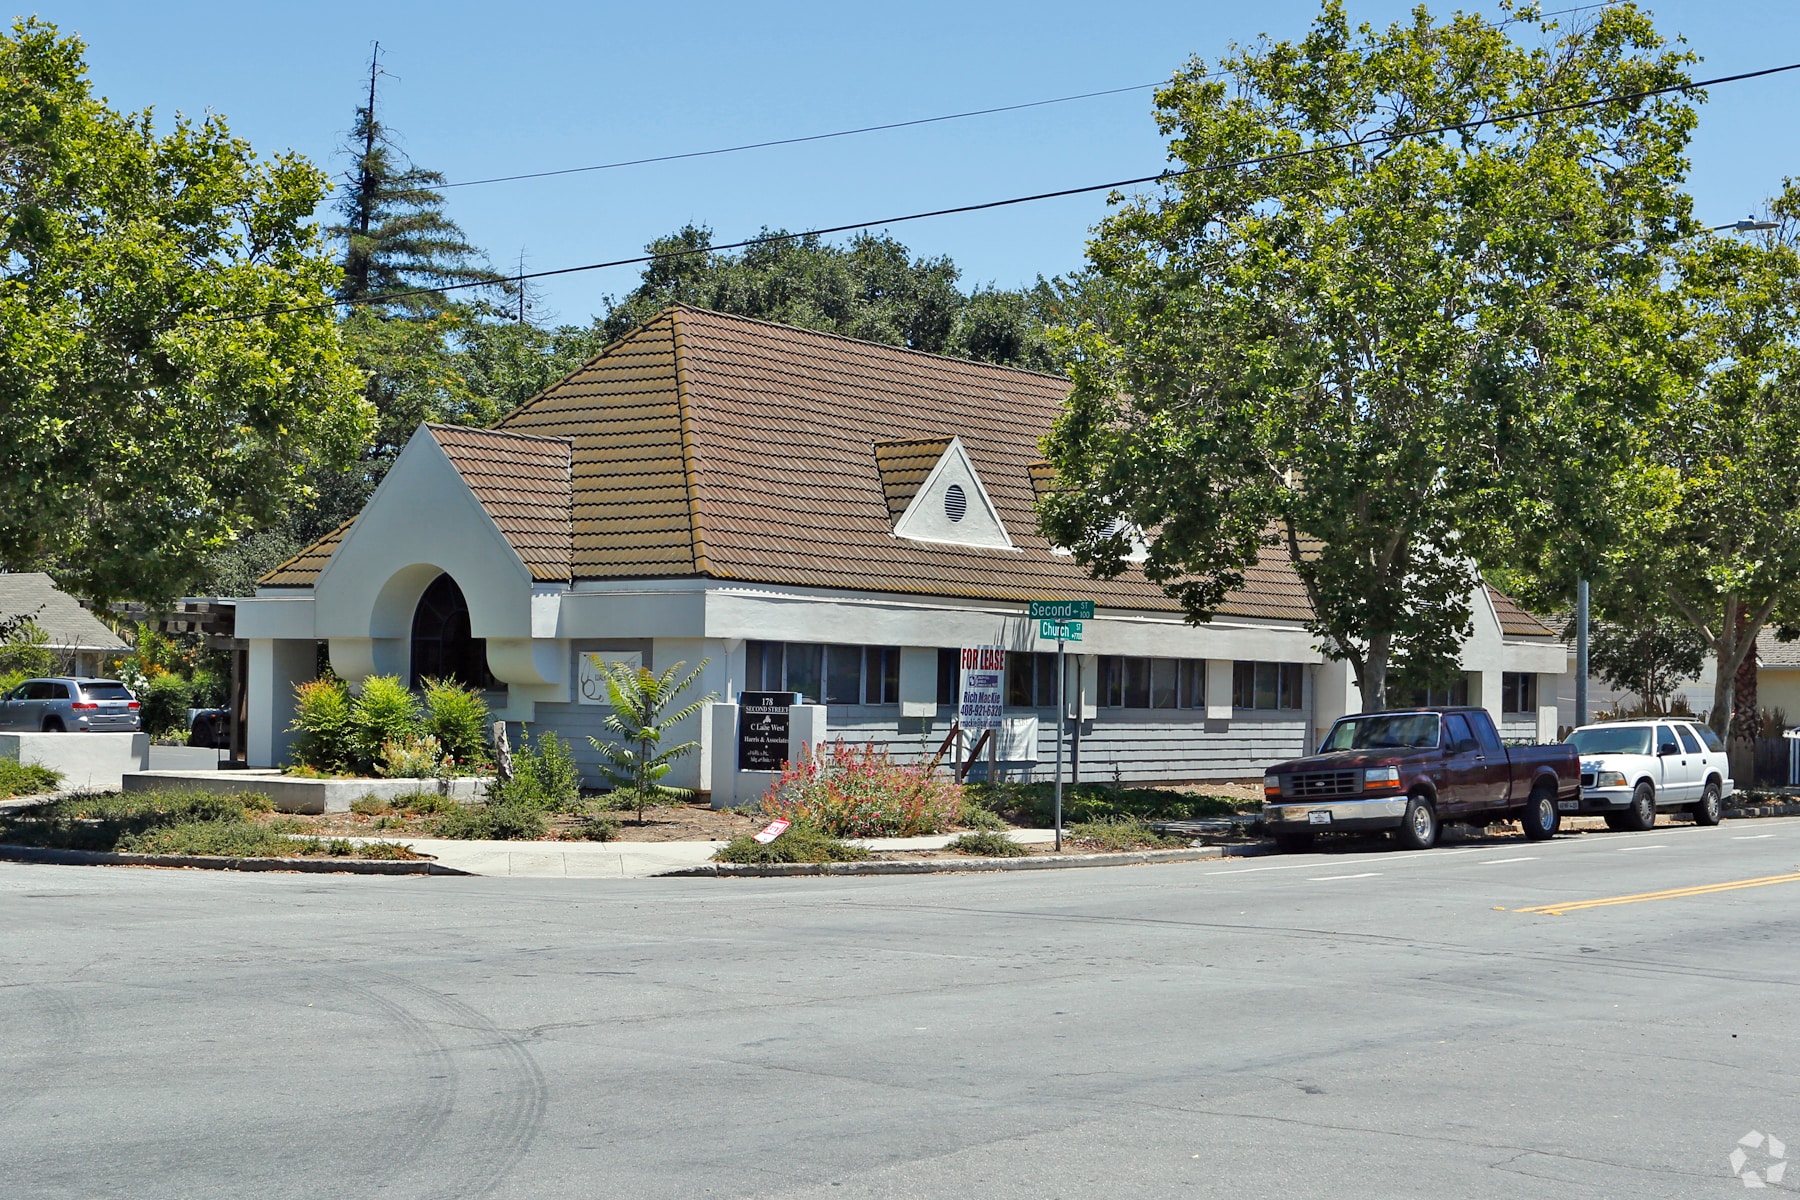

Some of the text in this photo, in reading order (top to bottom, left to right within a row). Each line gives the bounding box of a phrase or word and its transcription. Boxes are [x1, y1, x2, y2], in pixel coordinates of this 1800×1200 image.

[1032, 602, 1088, 616] Second ST
[1042, 622, 1081, 637] Church ST
[962, 648, 1005, 670] FOR LEASE
[964, 692, 977, 703] Rich
